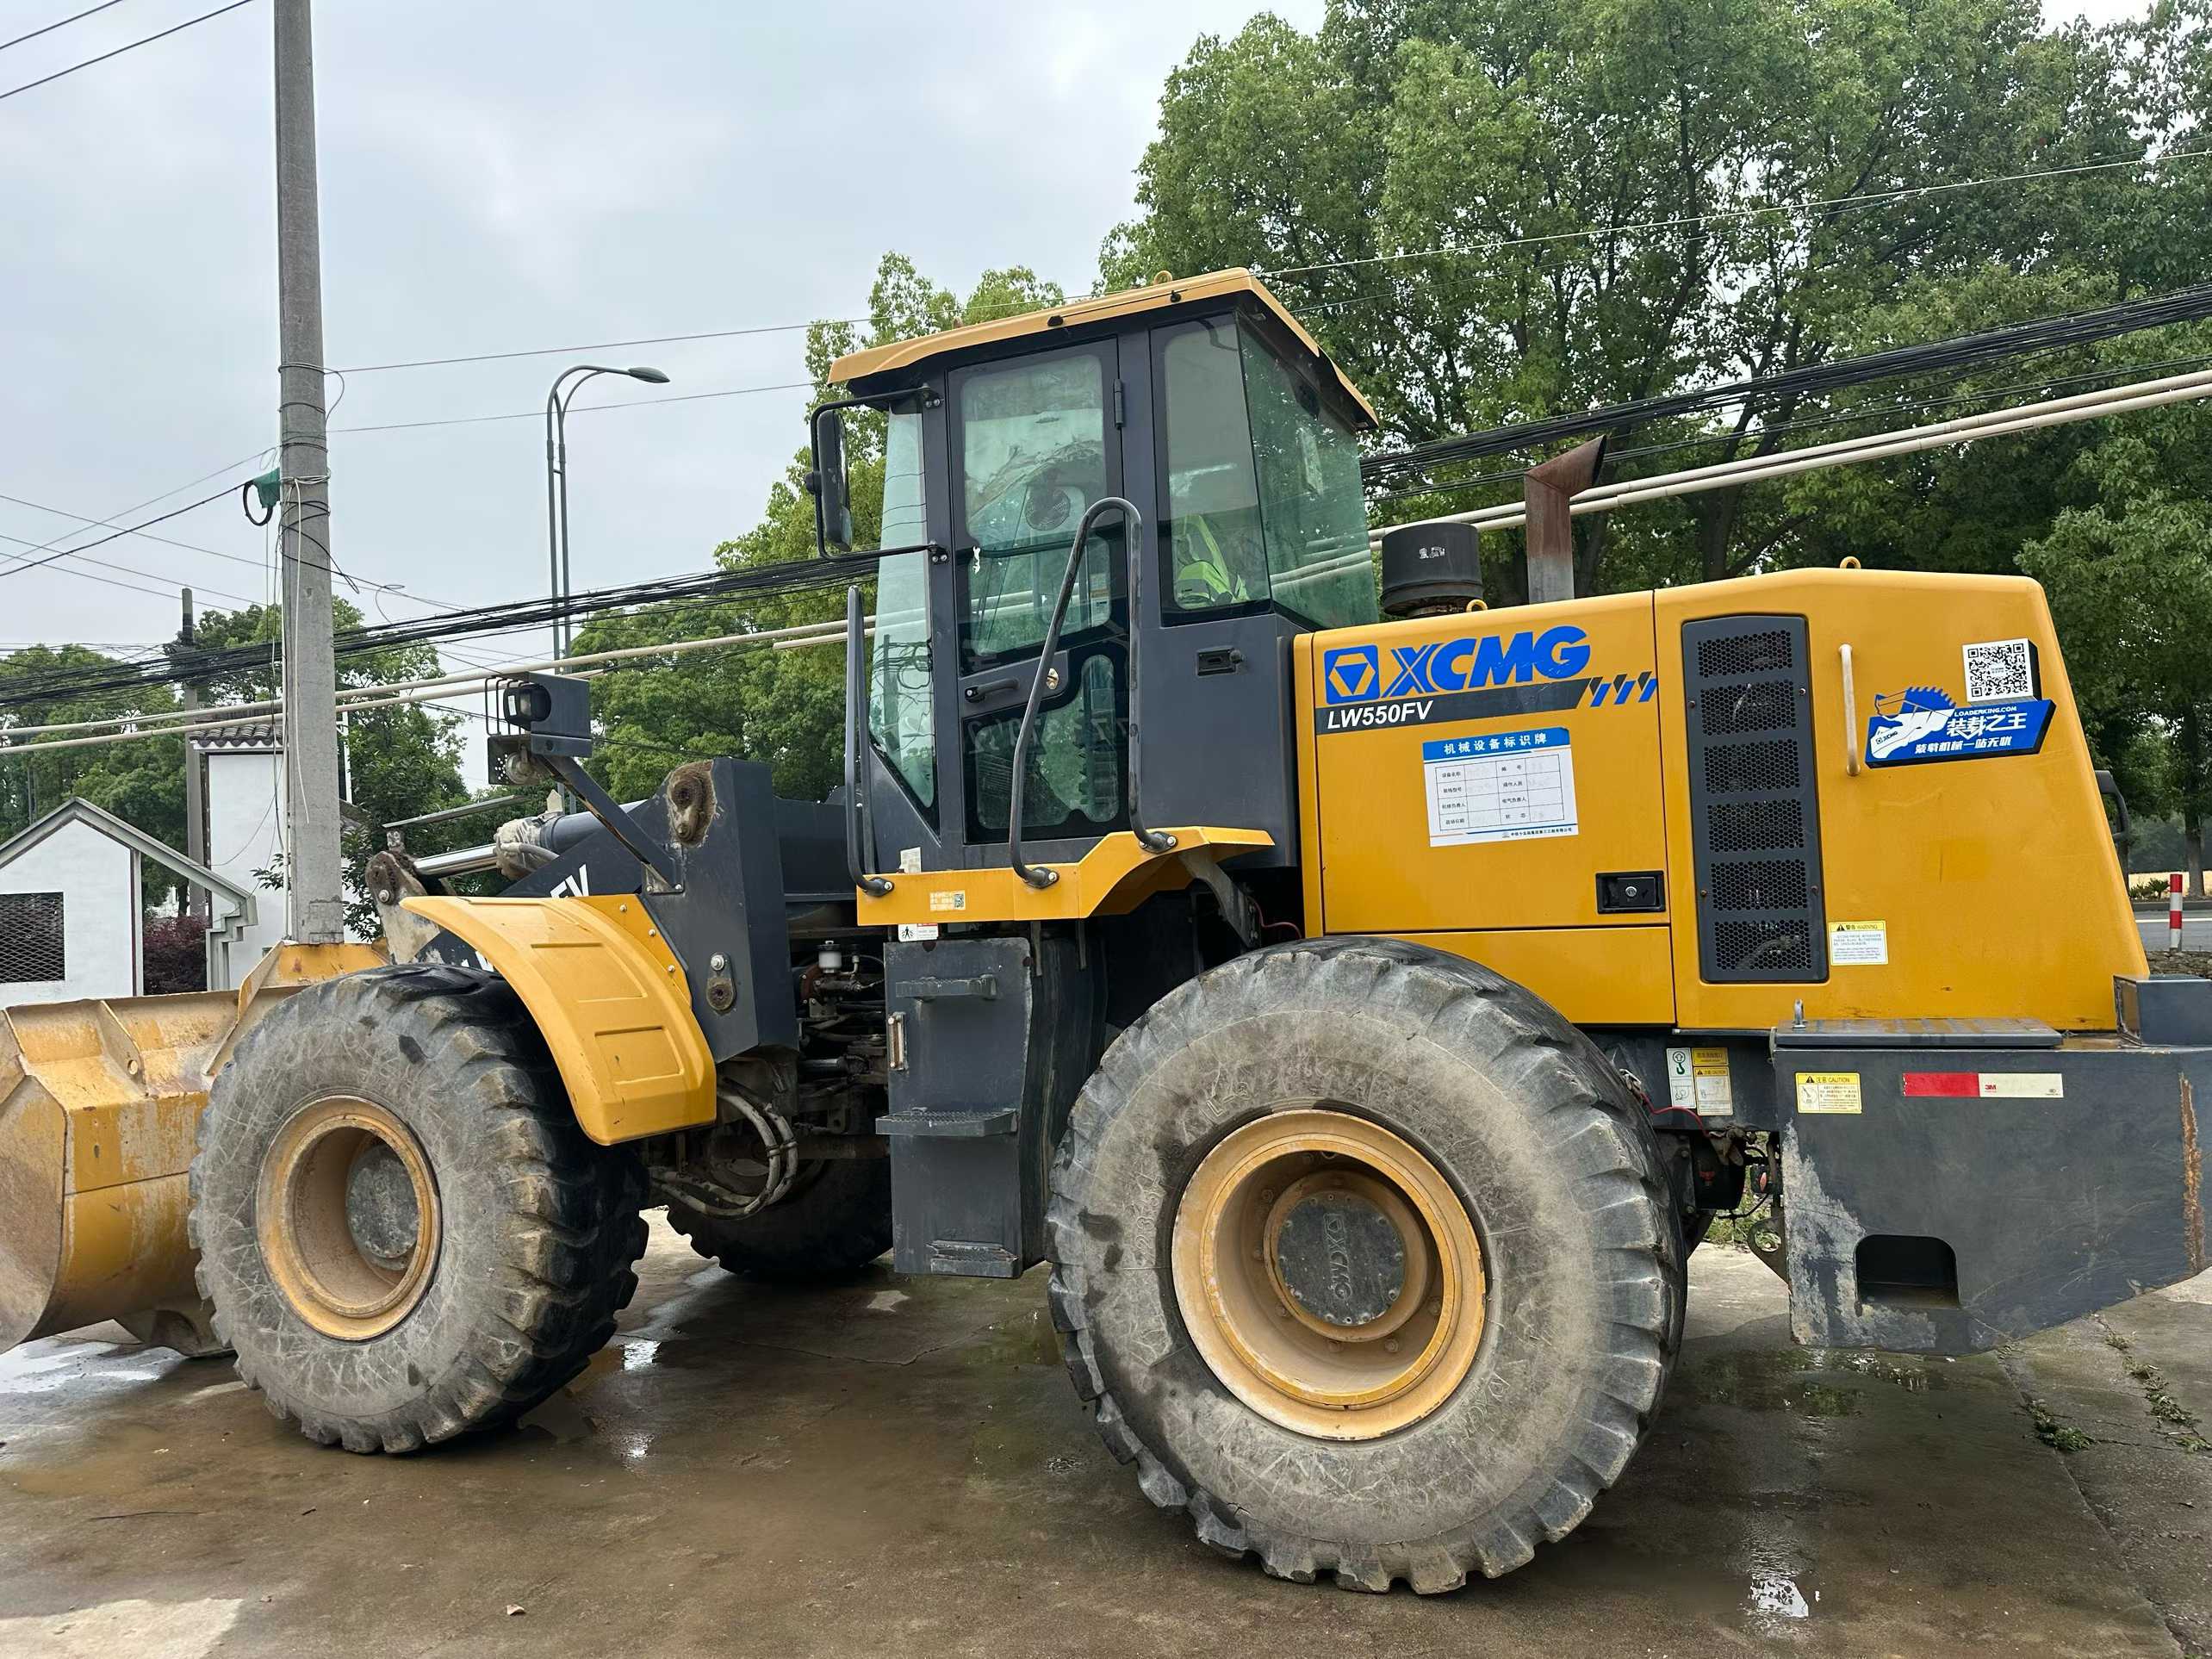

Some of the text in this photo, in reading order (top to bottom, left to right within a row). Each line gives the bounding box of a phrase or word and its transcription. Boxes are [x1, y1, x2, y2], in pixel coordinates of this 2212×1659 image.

[1380, 625, 1591, 697] XCMG
[1327, 700, 1433, 730] LW550FV
[1954, 705, 2017, 718] LOADERKING.COM
[1946, 712, 2028, 740] 装载之王
[1443, 732, 1548, 755] 机械设备标识牌
